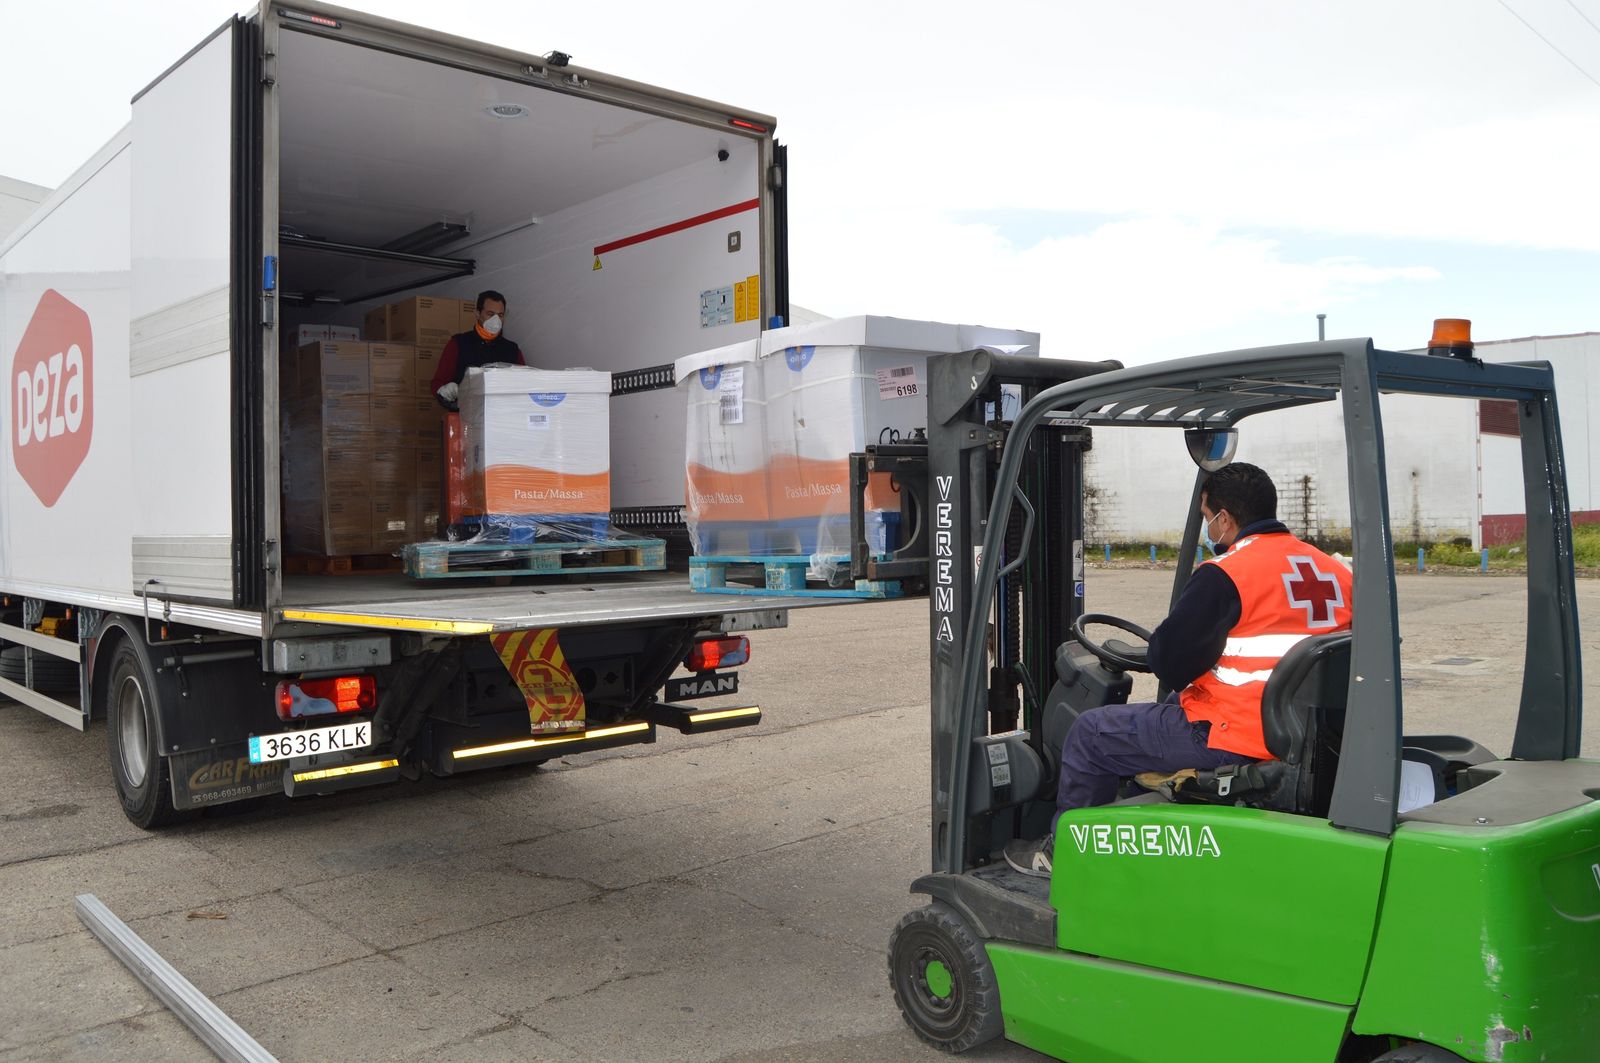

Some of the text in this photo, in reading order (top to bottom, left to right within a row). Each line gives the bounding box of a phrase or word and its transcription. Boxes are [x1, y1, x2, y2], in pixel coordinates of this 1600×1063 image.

[897, 384, 917, 396] 6198
[514, 488, 584, 500] Pasta/Massa
[696, 492, 744, 505] Pasta/Massa
[785, 483, 842, 498] Pasta/Massa
[935, 476, 953, 641] VEREMA
[679, 677, 734, 696] MAN
[267, 725, 366, 758] 3636 KLK
[1069, 824, 1221, 857] VEREMA
